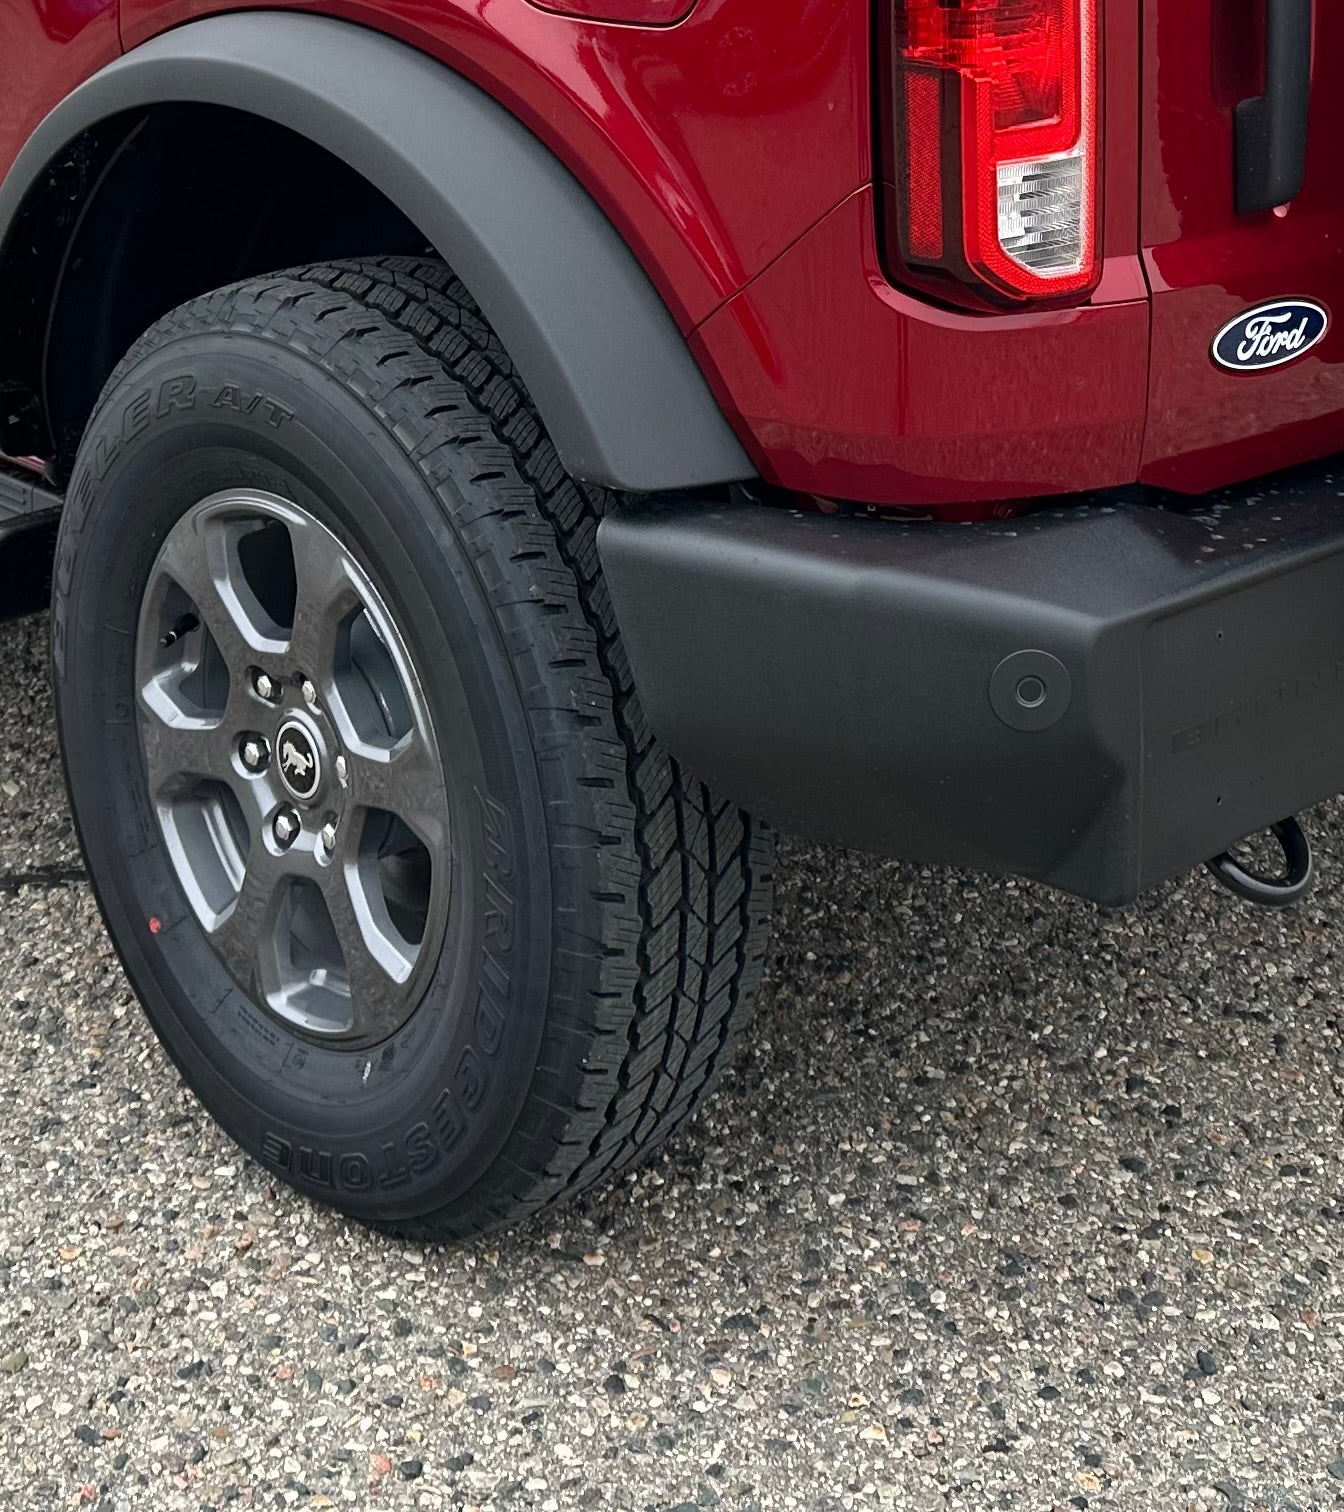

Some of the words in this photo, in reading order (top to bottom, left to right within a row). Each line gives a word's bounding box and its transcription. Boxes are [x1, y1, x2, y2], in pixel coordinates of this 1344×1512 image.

[1236, 311, 1309, 361] Ford
[212, 380, 296, 431] A/T
[258, 785, 520, 1194] BRIDGESTONE
